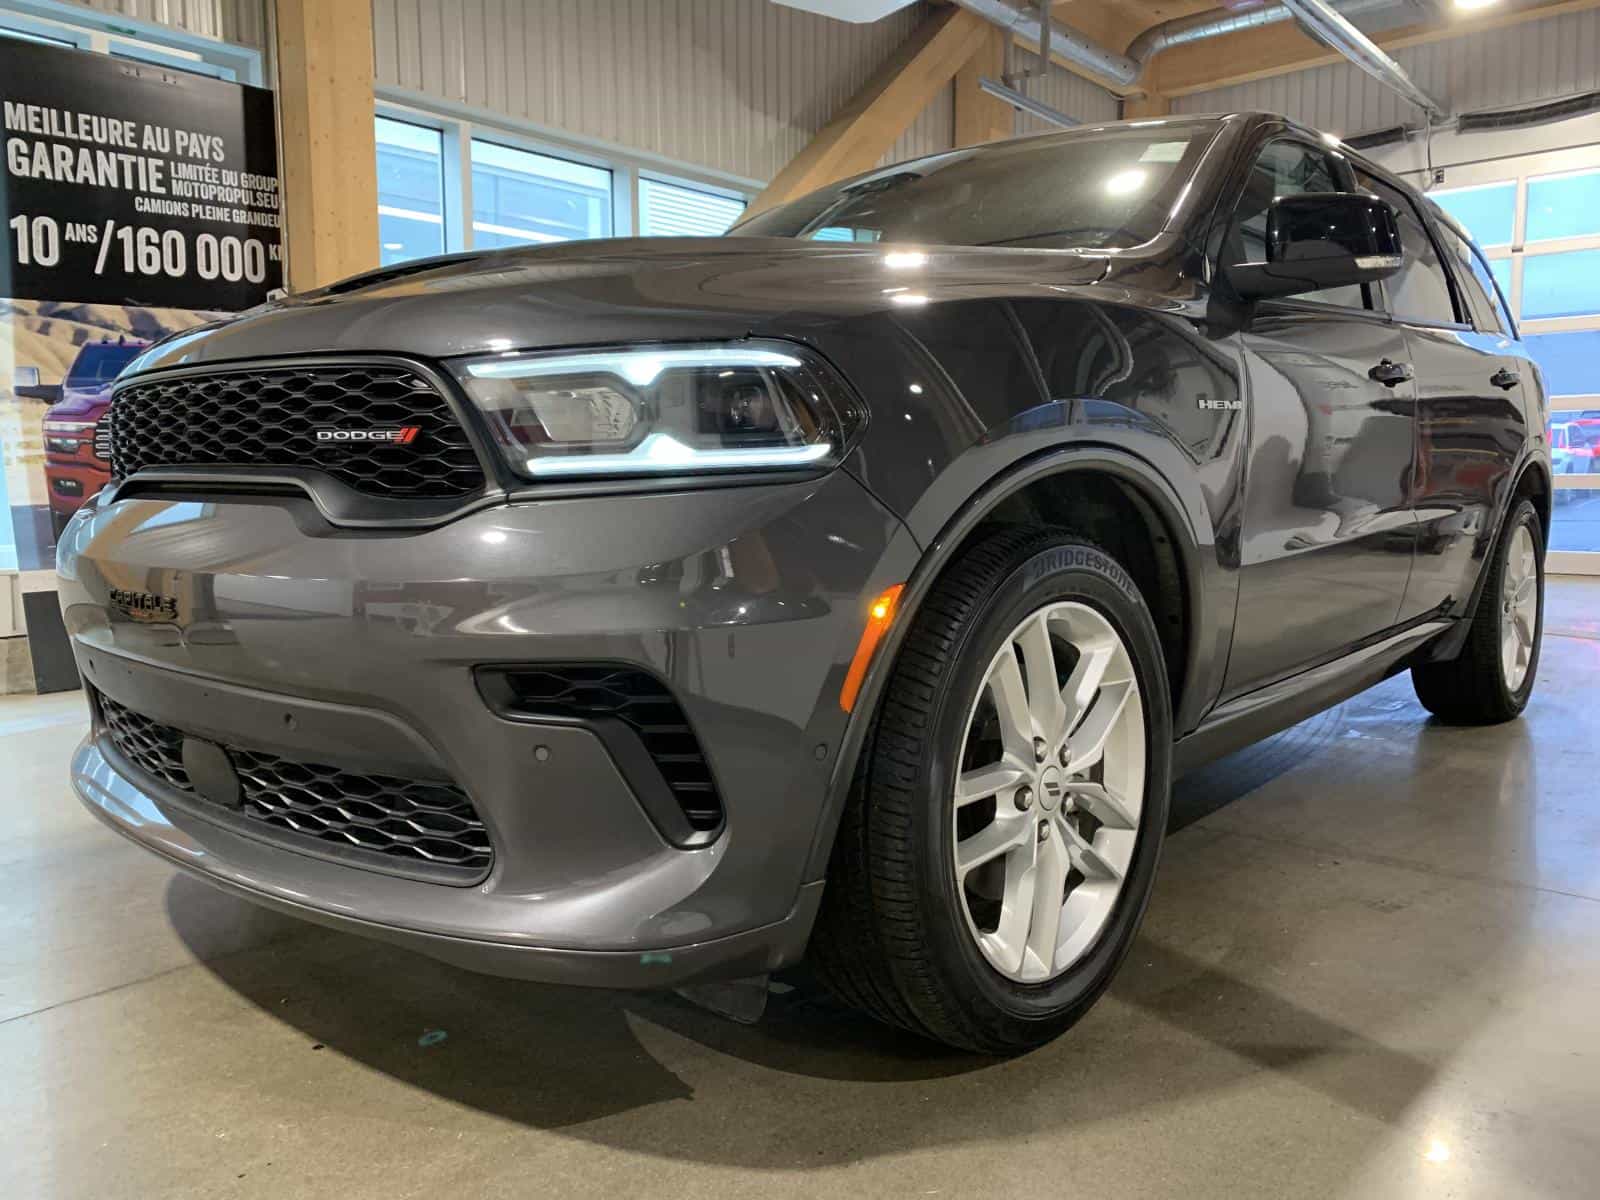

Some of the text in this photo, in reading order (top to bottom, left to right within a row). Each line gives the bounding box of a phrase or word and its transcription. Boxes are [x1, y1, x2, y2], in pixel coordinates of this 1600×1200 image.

[4, 101, 225, 161] MEILLEURE AU PAYS
[7, 138, 166, 194] GARANTIE
[170, 161, 219, 185] LIMITÉE
[222, 171, 238, 187] DU
[135, 197, 189, 217] CAMIONS
[192, 205, 231, 222] PLEINE
[10, 214, 59, 267] 10
[64, 222, 98, 243] ANS
[196, 233, 266, 283] 000
[316, 431, 404, 440] DODGE
[1032, 549, 1139, 599] BRIDGESTONE
